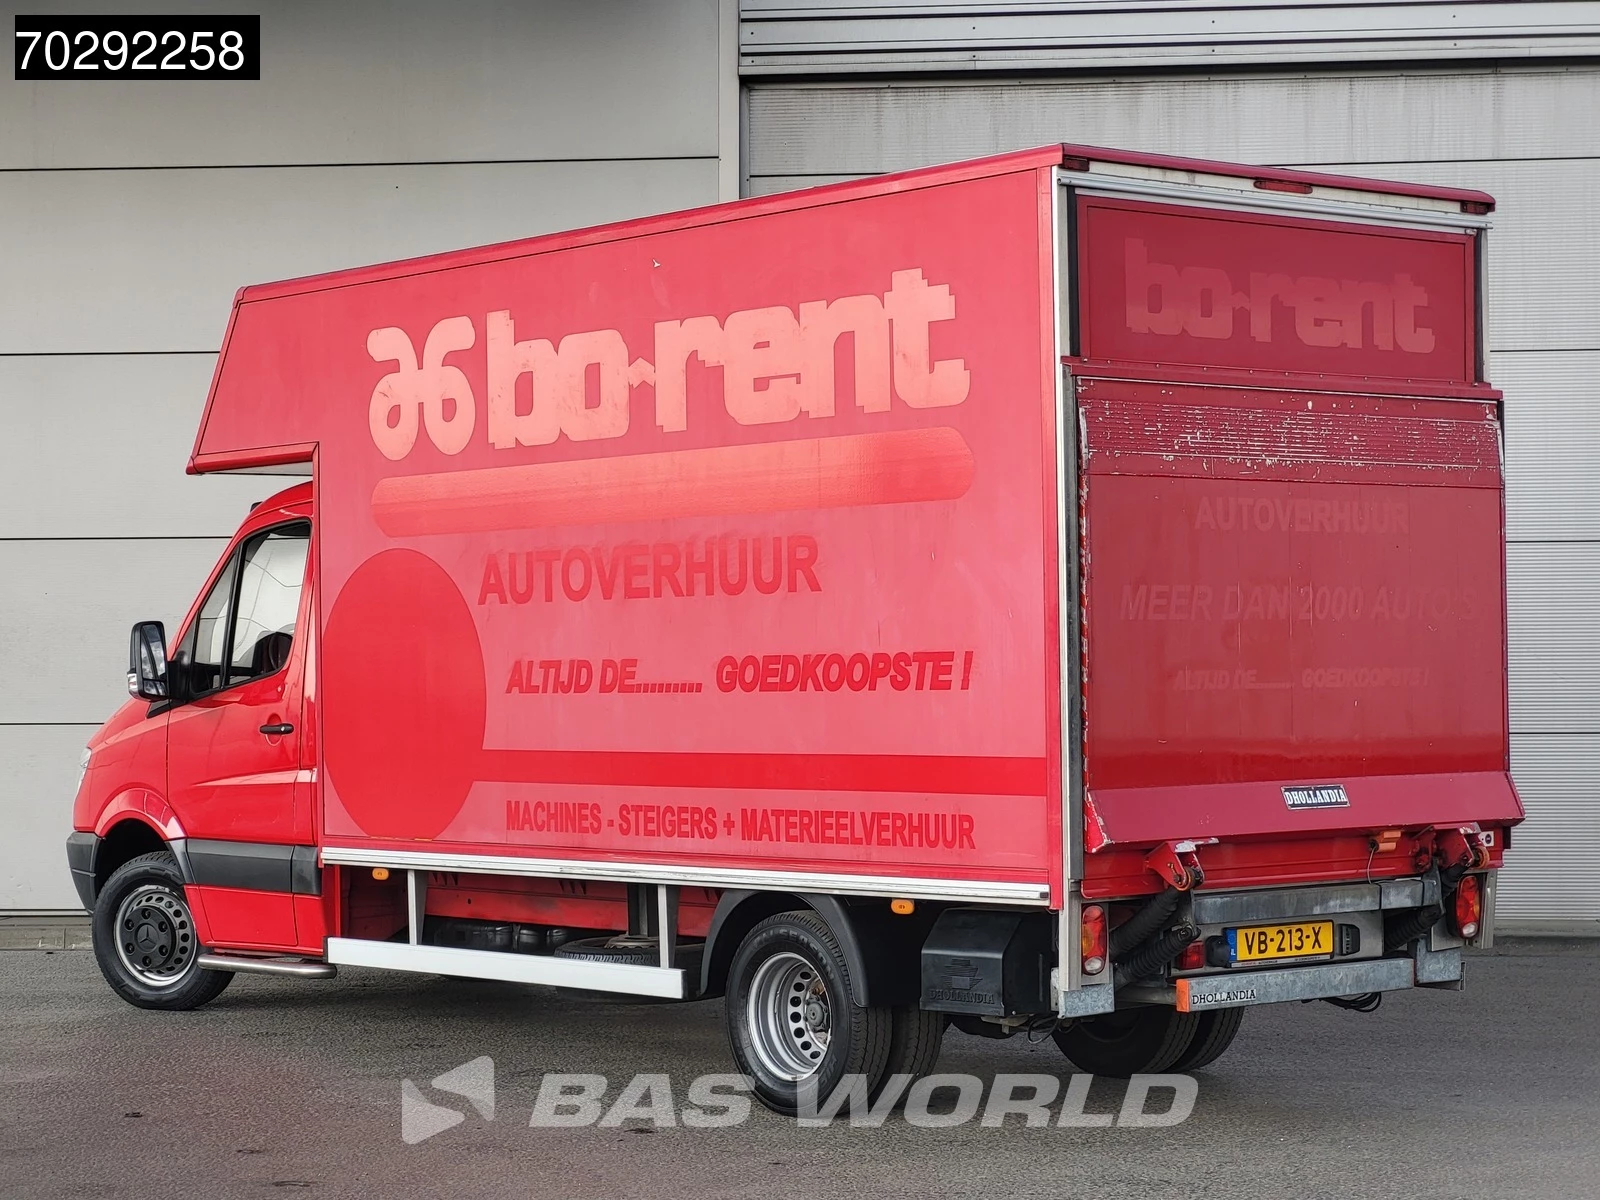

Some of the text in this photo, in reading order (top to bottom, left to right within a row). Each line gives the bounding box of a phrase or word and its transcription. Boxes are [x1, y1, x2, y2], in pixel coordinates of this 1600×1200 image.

[1194, 497, 1410, 535] AUTOVERHUUR
[478, 535, 823, 605] AUTOVERHUUR
[1119, 583, 1214, 621] MEER
[1222, 584, 1291, 621] DAN
[1297, 586, 1365, 621] 2000
[505, 659, 594, 695] ALTIJD
[715, 651, 956, 693] GOEDKOOPSTE
[1172, 669, 1230, 692] ALTIJD
[1285, 789, 1347, 806] DHOLLANDIA
[506, 800, 602, 835] MACHINES
[618, 806, 718, 841] STEIGERS
[741, 808, 976, 851] MATERIEELVERHUUR
[1245, 926, 1322, 955] VB-213-X
[928, 988, 996, 1005] DHOLLANDIA
[1192, 989, 1256, 1006] DHOLLANDIA
